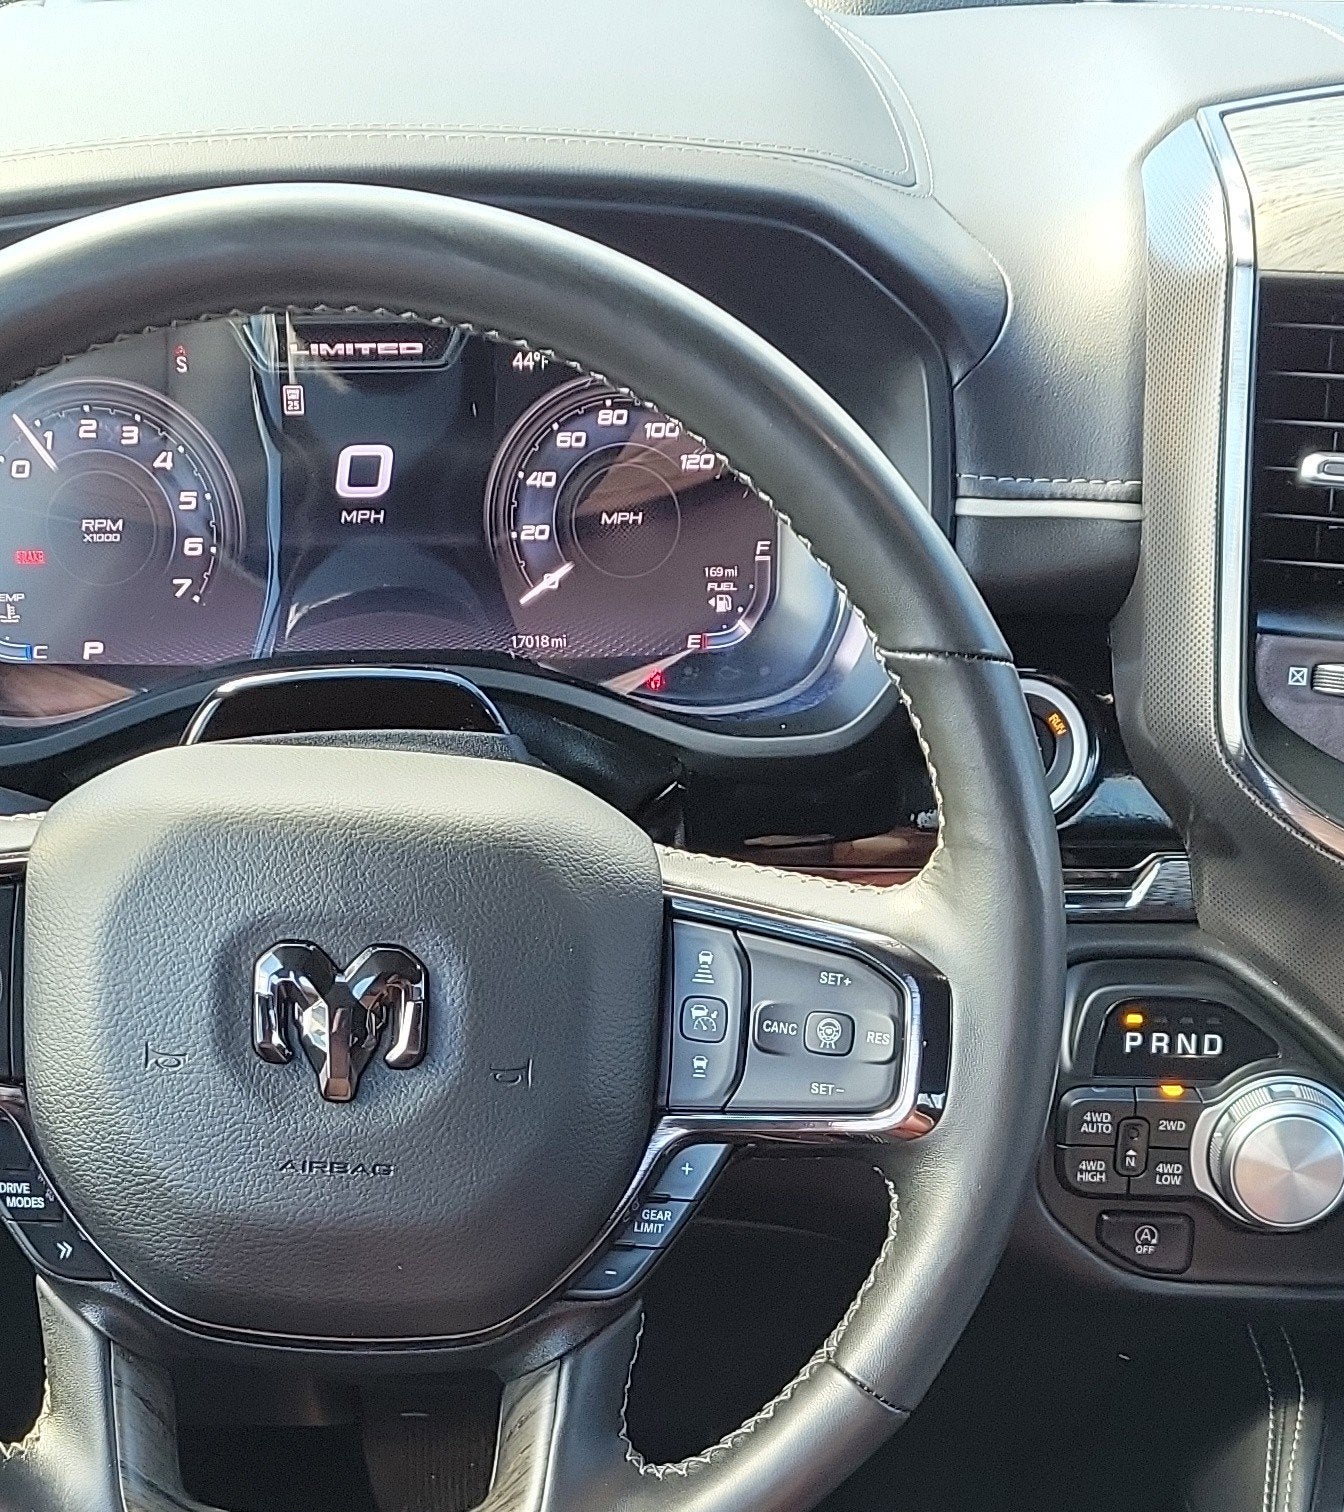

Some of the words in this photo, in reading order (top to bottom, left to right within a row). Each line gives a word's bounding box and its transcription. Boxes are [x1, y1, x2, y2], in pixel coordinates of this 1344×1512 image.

[289, 342, 424, 357] LIMITED
[597, 408, 628, 427] 80
[78, 420, 98, 438] 2
[121, 425, 139, 444] 3
[644, 422, 680, 440] 100
[43, 431, 56, 449] 1
[556, 431, 587, 449] 60
[11, 460, 30, 478] 0
[153, 451, 174, 470] 4
[680, 453, 716, 472] 120
[335, 444, 395, 499] 0
[526, 470, 557, 489] 40
[178, 491, 198, 510] 5
[81, 518, 123, 533] RPM
[340, 509, 385, 525] MPH
[600, 511, 643, 527] MPH
[521, 523, 551, 541] 20
[183, 538, 203, 556] 6
[172, 578, 193, 598] 7
[707, 582, 737, 592] FUEL
[82, 641, 105, 660] P
[762, 1019, 798, 1036] CANC
[866, 1031, 891, 1046] RES
[1083, 1111, 1111, 1122] 4WD
[1080, 1123, 1112, 1134] AUTO
[1158, 1120, 1186, 1131] 2WD
[279, 1159, 396, 1177] AIRBAG
[1078, 1160, 1106, 1171] 4WD
[1155, 1163, 1183, 1174] 4WD
[1076, 1171, 1106, 1183] HIGH
[1155, 1174, 1182, 1185] LOW
[6, 1196, 45, 1209] MODES
[641, 1209, 672, 1221] GEAR
[633, 1222, 665, 1234] LIMIT
[1135, 1244, 1155, 1255] OFF
